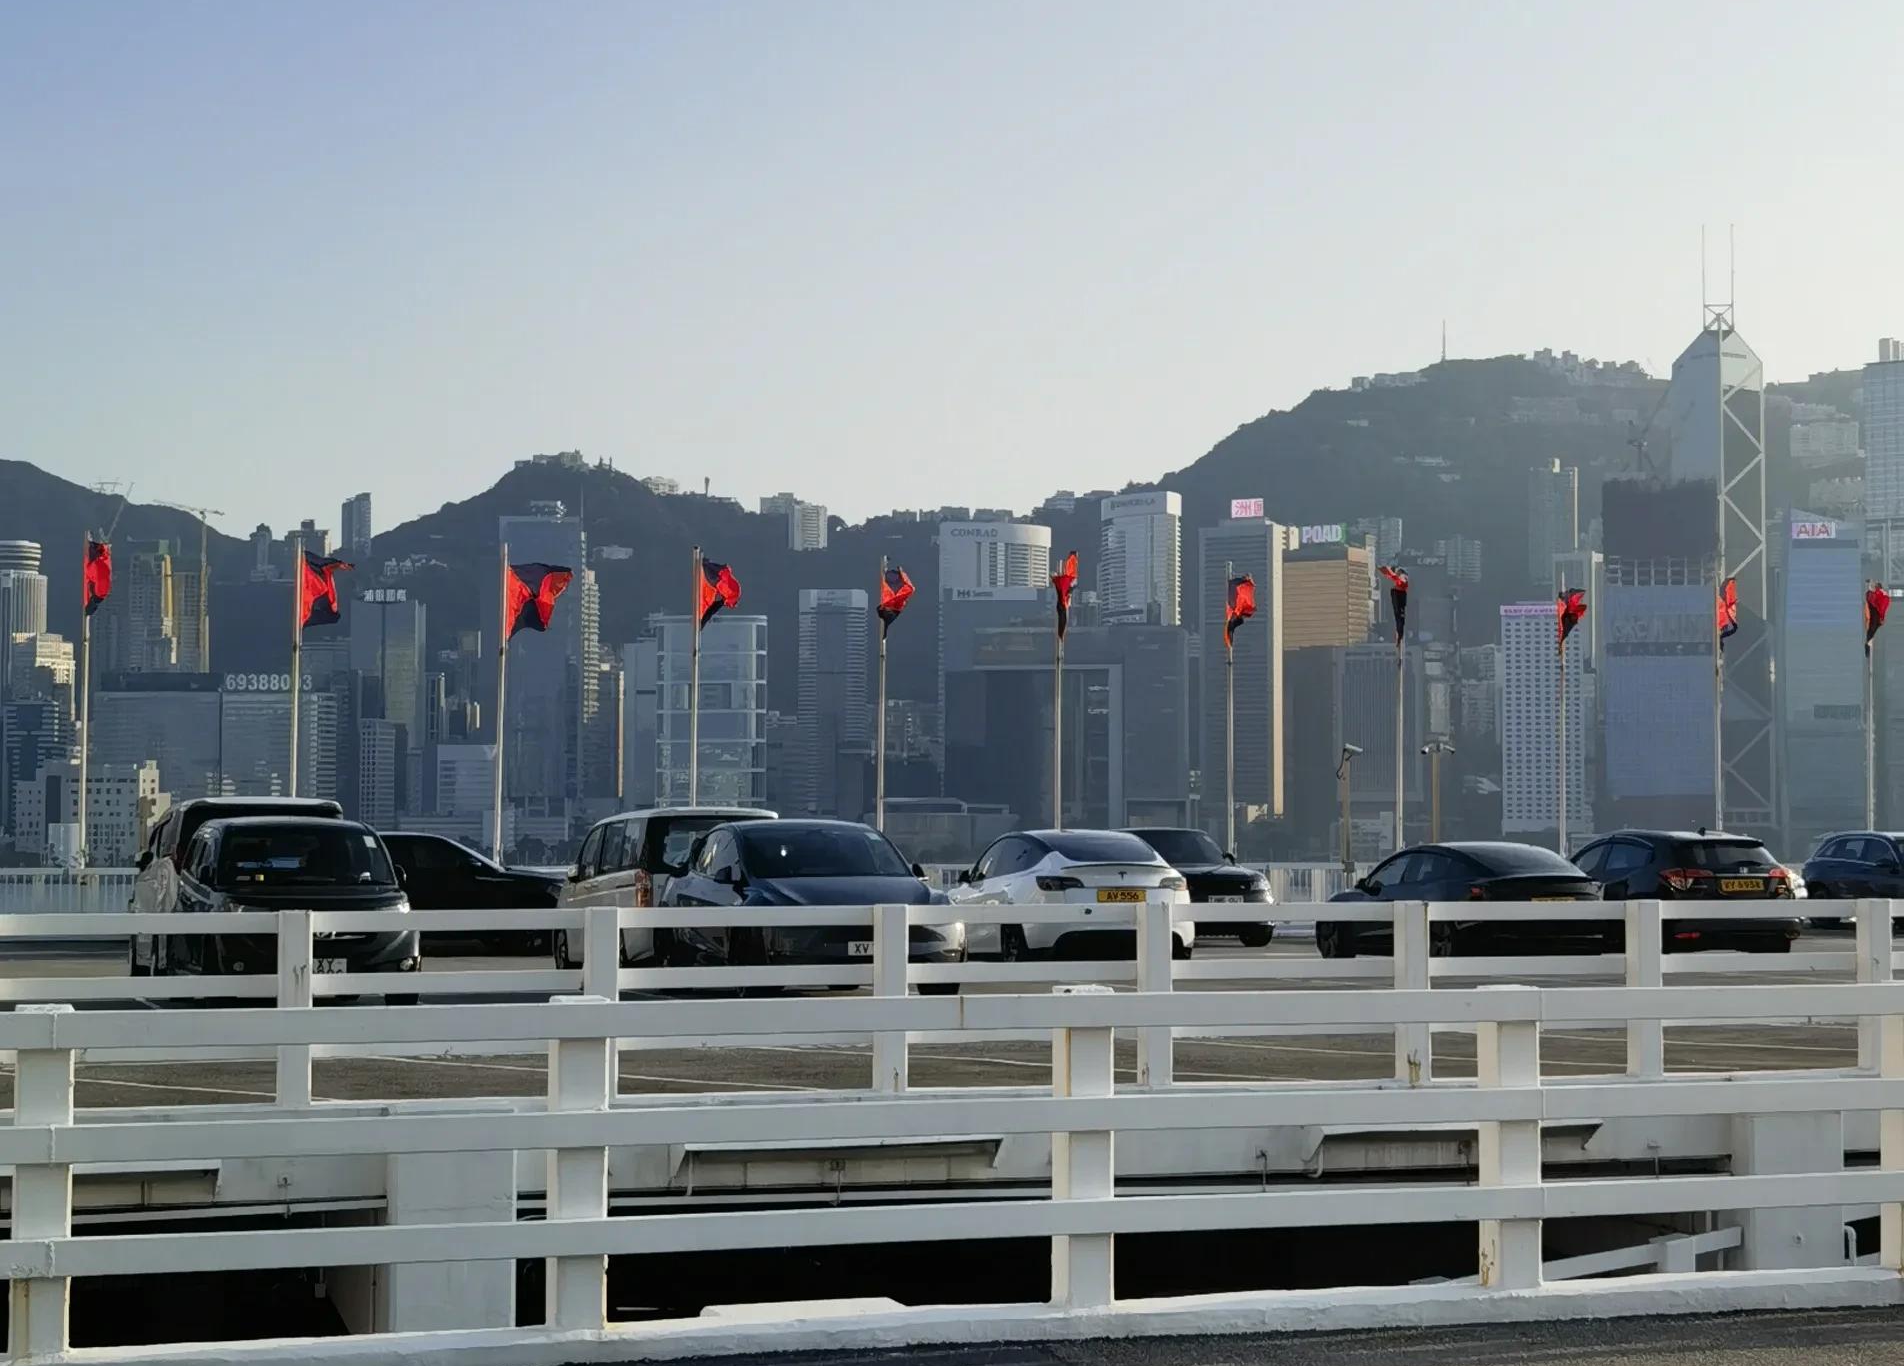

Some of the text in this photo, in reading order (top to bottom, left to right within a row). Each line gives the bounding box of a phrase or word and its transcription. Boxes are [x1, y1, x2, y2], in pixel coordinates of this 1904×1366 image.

[950, 528, 998, 537] CONRAD
[1302, 524, 1342, 543] POAD
[1797, 524, 1830, 537] AIA
[226, 674, 312, 690] 6938803
[1120, 891, 1139, 900] 556
